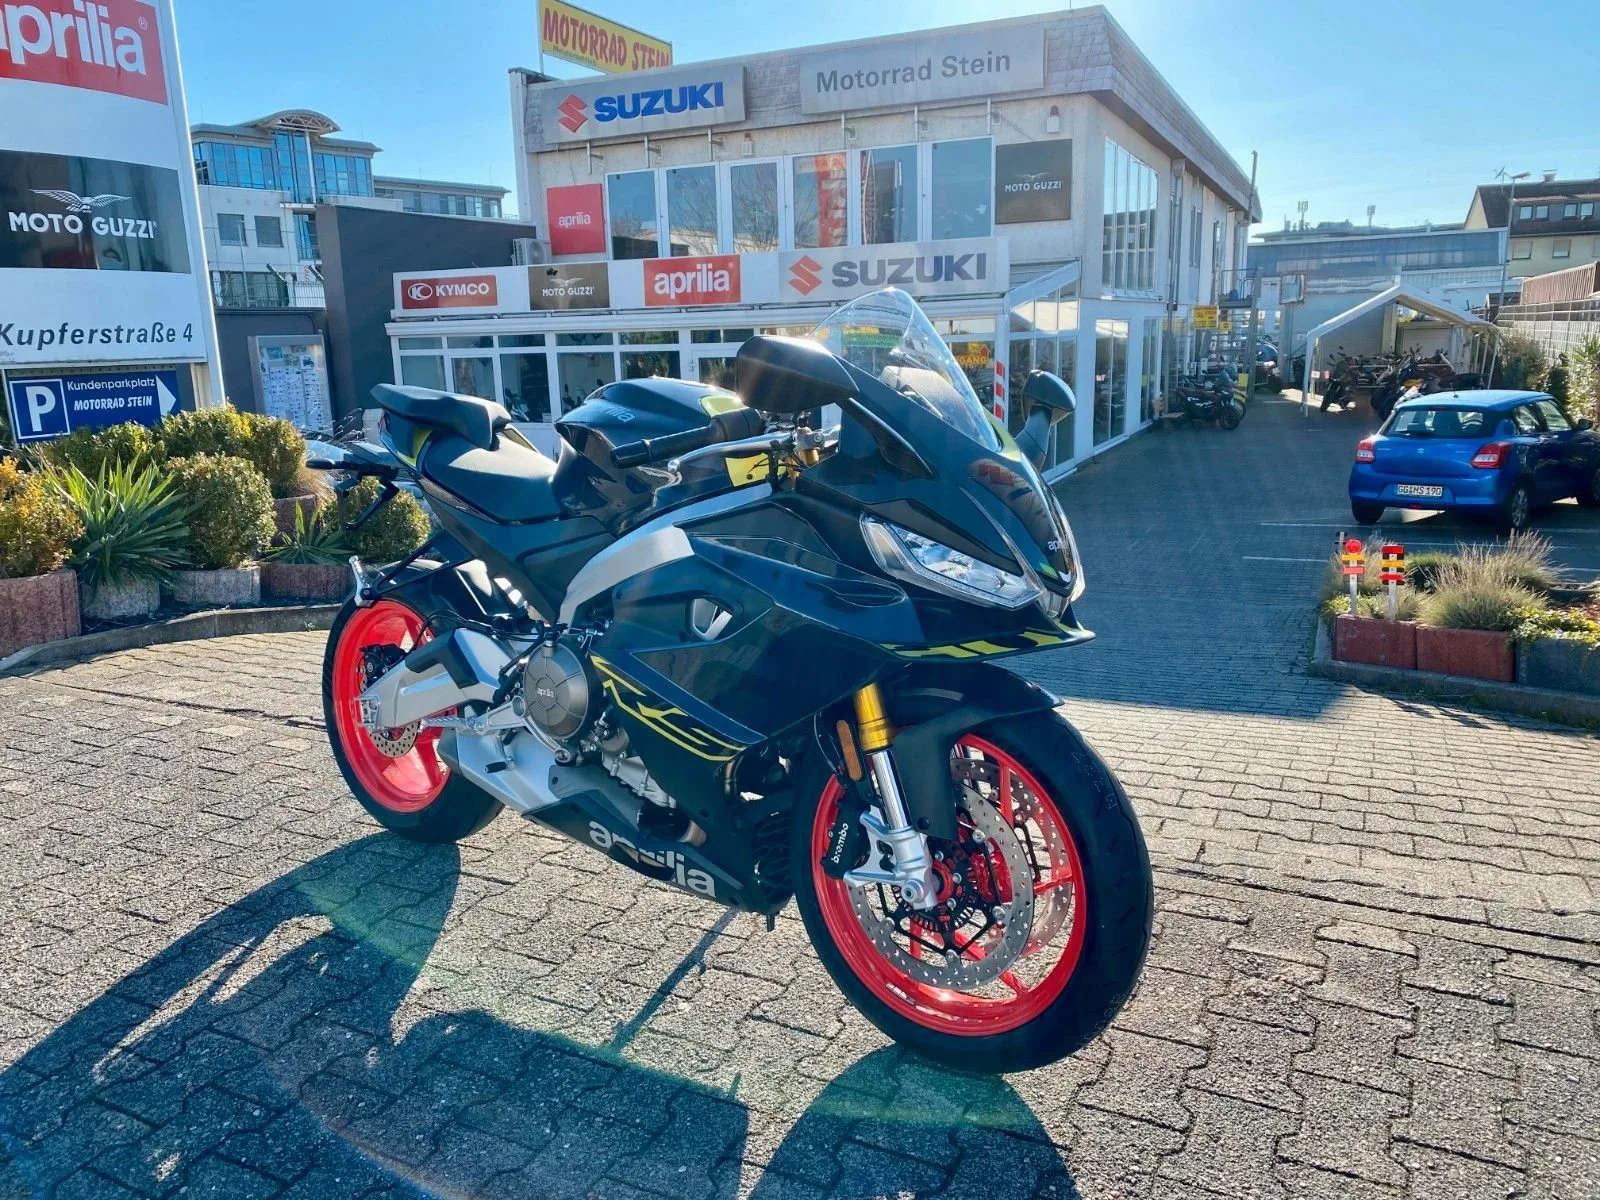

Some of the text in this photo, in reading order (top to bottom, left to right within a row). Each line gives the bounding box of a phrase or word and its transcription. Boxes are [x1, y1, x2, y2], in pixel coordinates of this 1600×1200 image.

[0, 0, 147, 75] prilia
[543, 7, 628, 66] MOTORRAD
[816, 51, 1010, 93] Motorrad Stein
[594, 81, 724, 122] SUZUKI
[1005, 180, 1062, 192] MOTO GUZZI
[8, 211, 154, 238] MOTO GUZZI
[558, 211, 591, 228] aprilia
[654, 263, 730, 299] aprilia
[832, 252, 987, 288] SUZUKI
[435, 282, 490, 297] KYMCO
[542, 286, 593, 297] MOTO GUZZI
[0, 321, 193, 350] Kupferstraße 4
[956, 355, 987, 365] GANG
[66, 377, 156, 391] Kundenparkplatz
[25, 385, 56, 432] P
[73, 396, 153, 412] MOTORRAD STEIN
[830, 822, 849, 864] brembo
